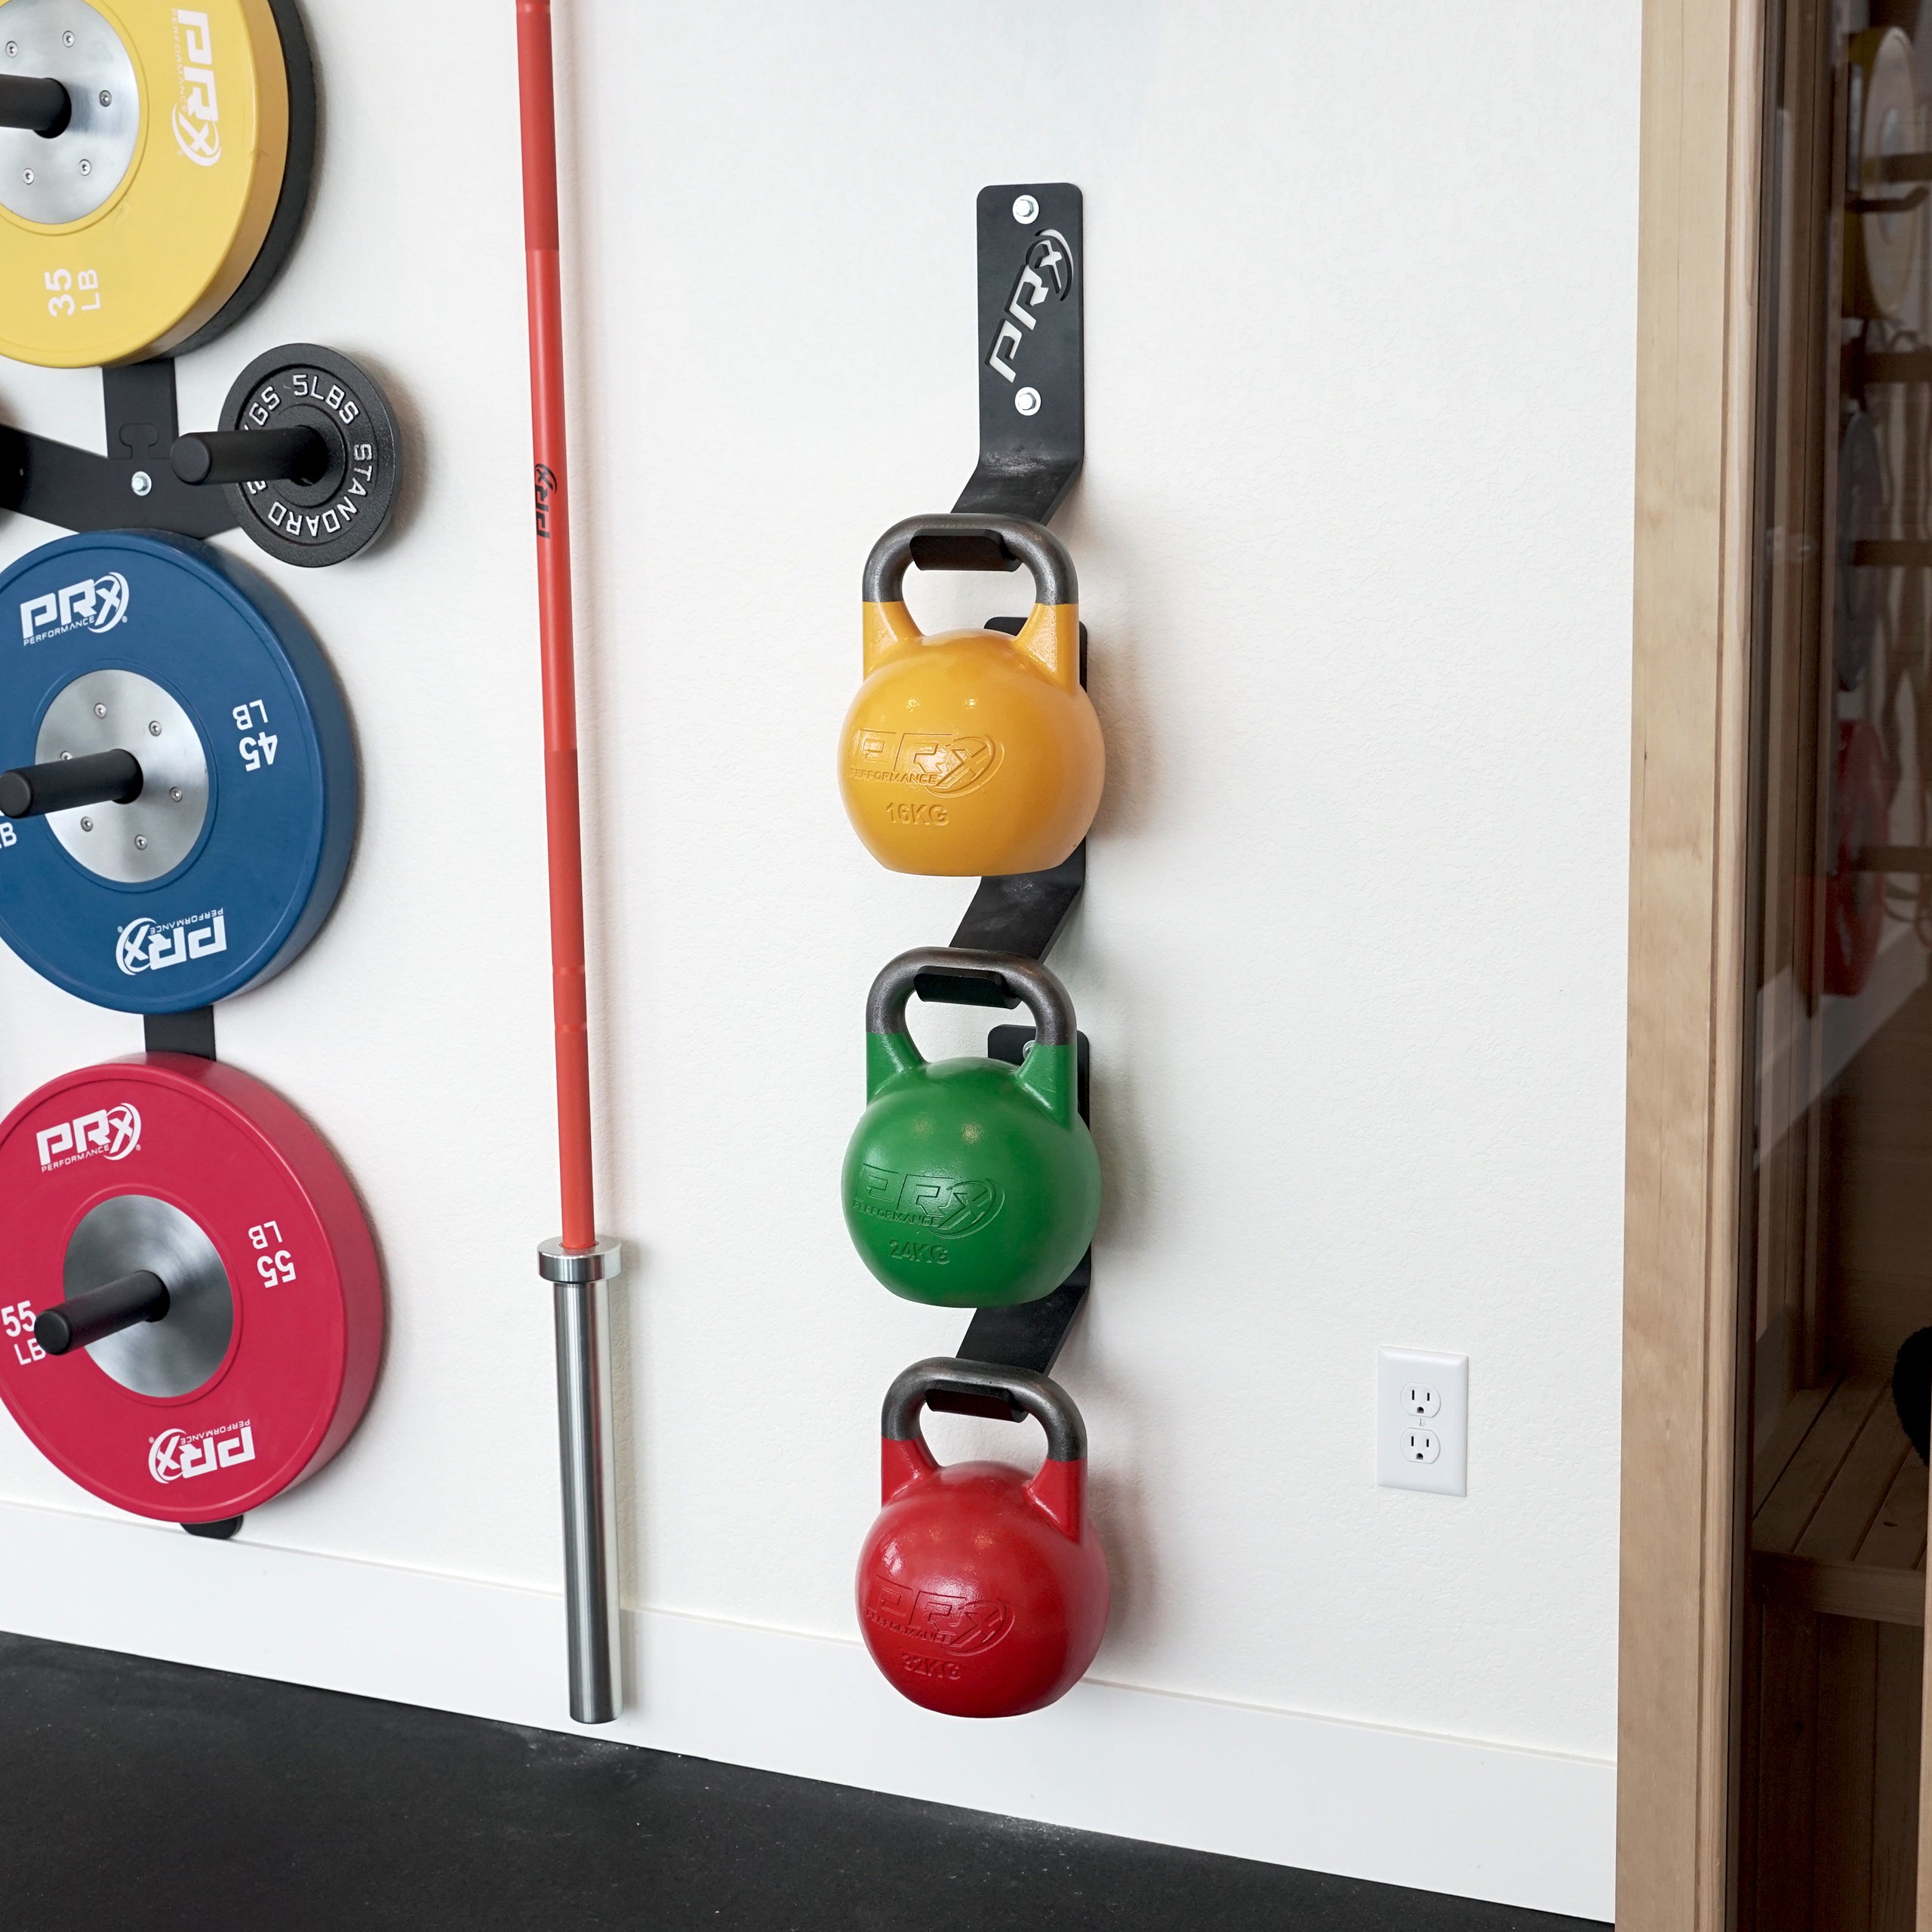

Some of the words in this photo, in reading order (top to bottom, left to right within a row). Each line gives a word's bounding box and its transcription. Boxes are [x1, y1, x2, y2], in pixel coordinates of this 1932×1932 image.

[171, 8, 188, 112] PERFORMANCE
[44, 269, 75, 317] 35
[78, 269, 100, 311] LB
[245, 386, 280, 430] GS
[293, 374, 360, 424] 5LBS
[268, 443, 373, 537] STANDARD
[23, 617, 95, 646] PERFORMANCE
[232, 700, 268, 731] LB
[239, 731, 278, 772] 45
[851, 767, 940, 786] PERFORMANCE
[886, 802, 949, 826] 16KG
[0, 822, 17, 849] B
[150, 908, 223, 934] PERFORMANCE
[42, 1144, 110, 1173] PERFORMANCE
[853, 1199, 941, 1227] PERFORMANCE
[248, 1220, 282, 1249] LB
[889, 1239, 949, 1265] 24KG
[257, 1250, 296, 1287] 55
[1, 1300, 36, 1337] 55
[14, 1338, 46, 1365] LB
[180, 1419, 251, 1444] PERFORMANCE
[866, 1608, 952, 1644] PERFORMANCE
